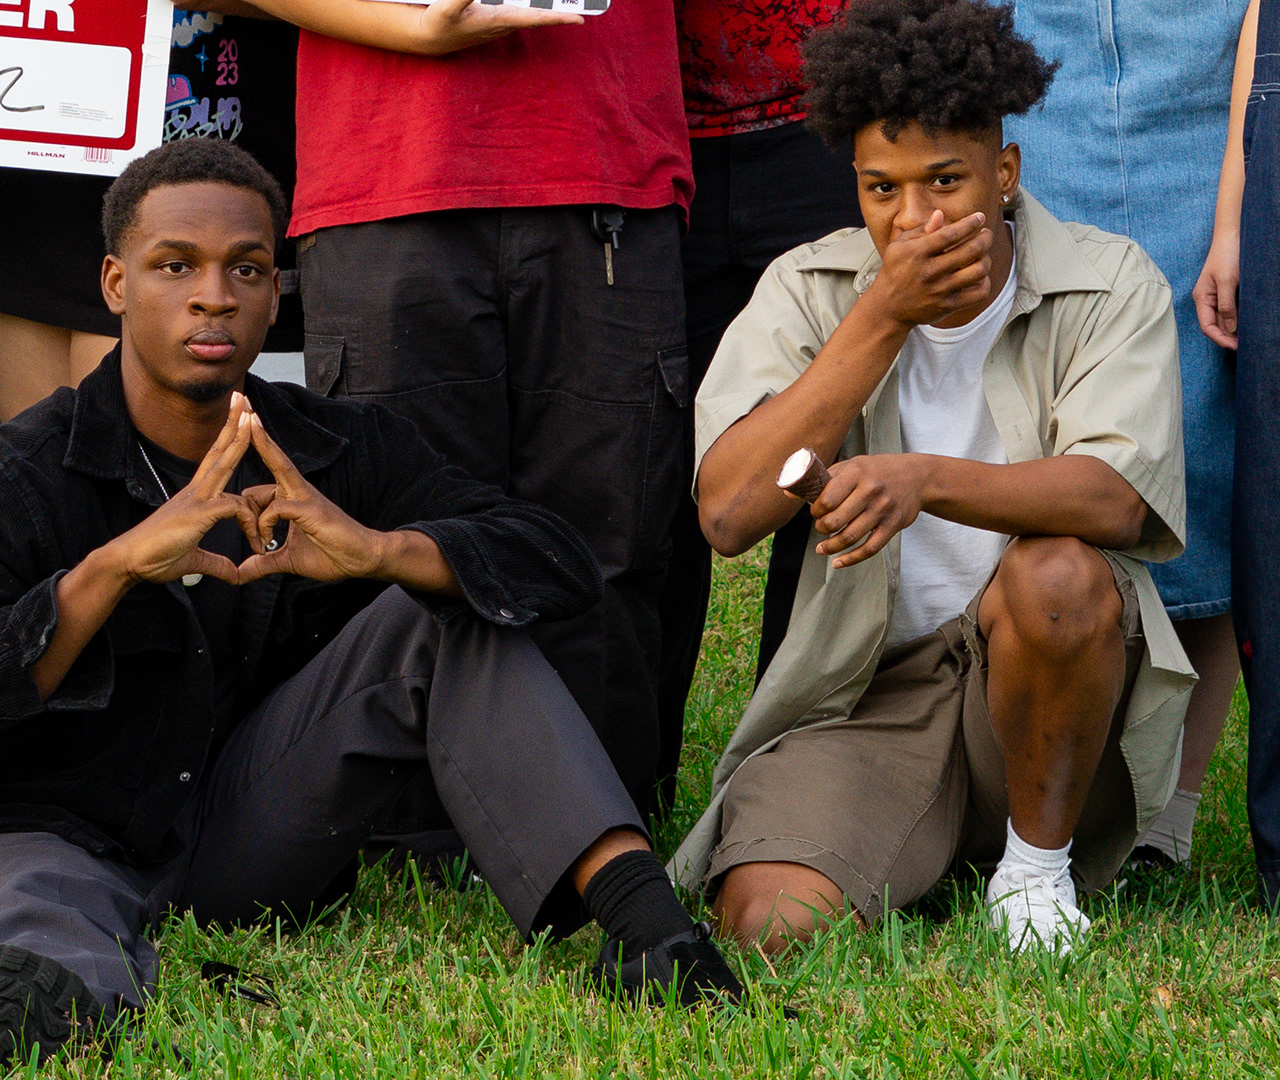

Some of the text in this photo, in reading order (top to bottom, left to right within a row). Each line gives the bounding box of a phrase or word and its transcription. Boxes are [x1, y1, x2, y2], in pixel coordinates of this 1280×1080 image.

[216, 38, 239, 62] 20
[215, 62, 239, 86] 23
[27, 150, 66, 159] HILLMAN
